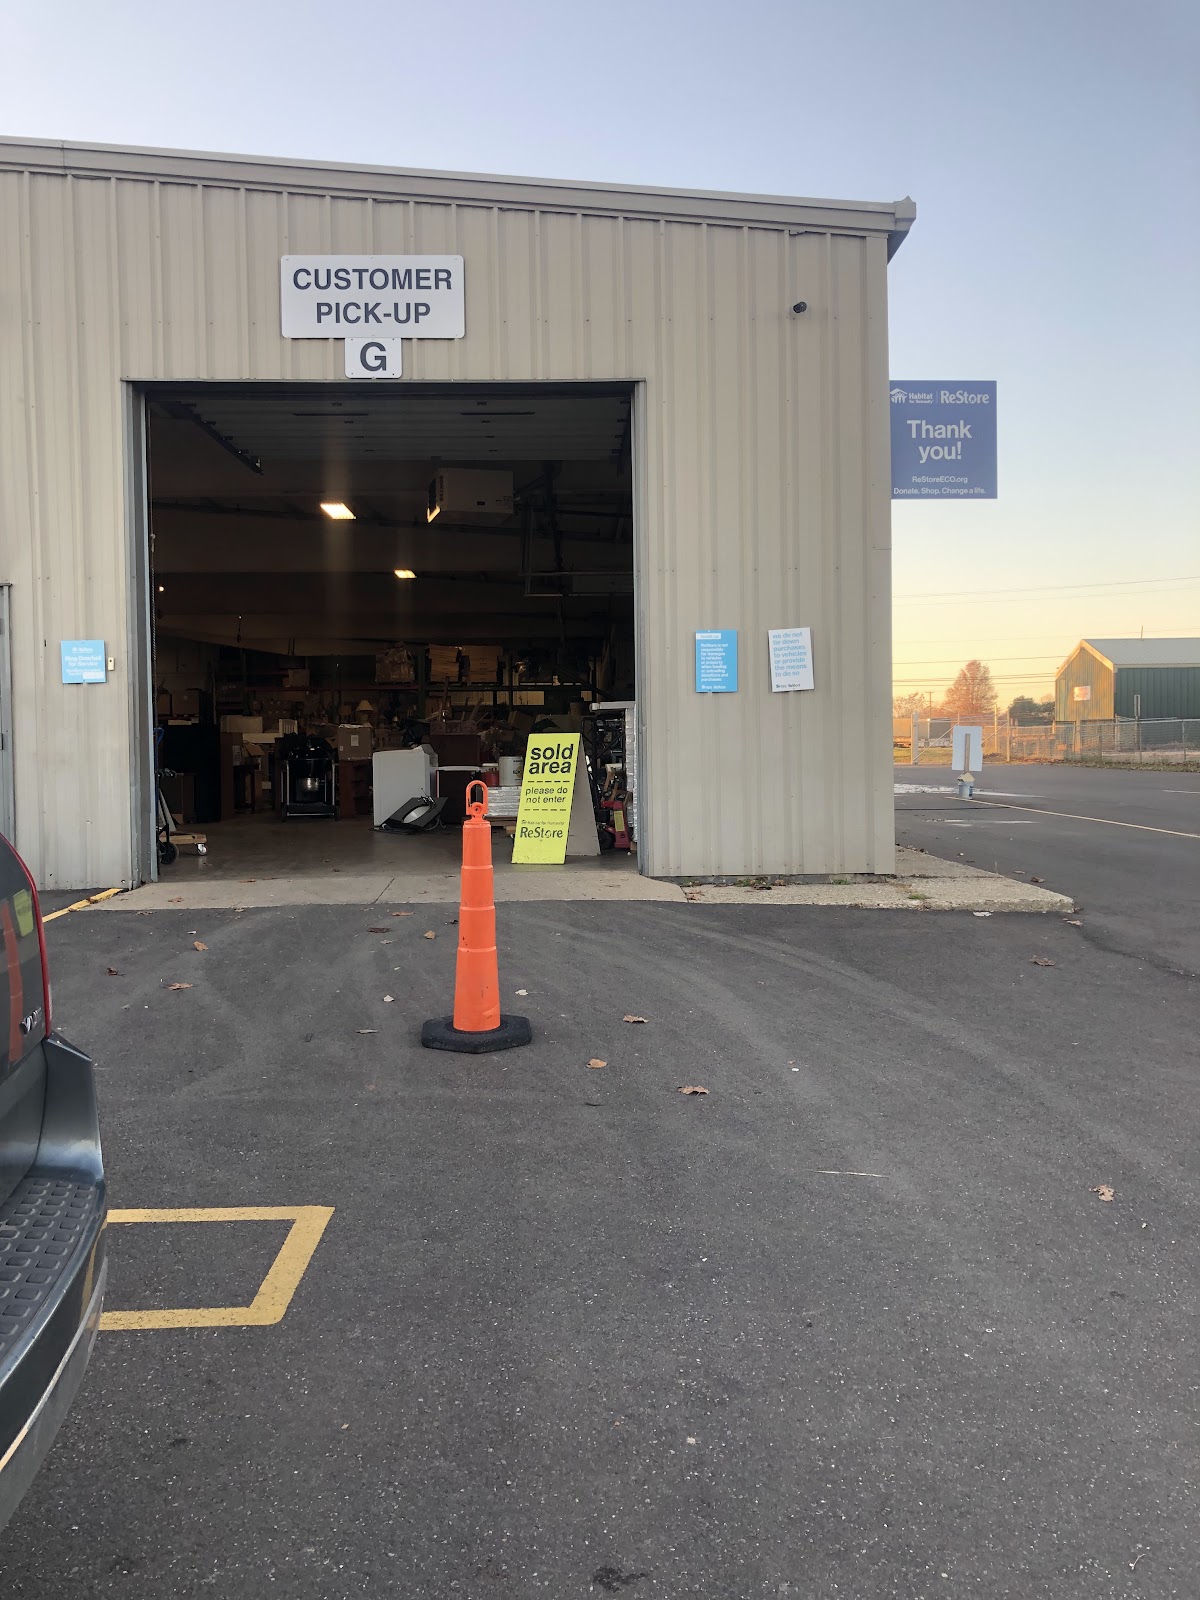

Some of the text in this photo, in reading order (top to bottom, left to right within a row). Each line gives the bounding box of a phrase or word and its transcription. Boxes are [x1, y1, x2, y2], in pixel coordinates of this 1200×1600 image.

[293, 268, 452, 290] CUSTOMER
[316, 302, 431, 324] PICK-UP
[360, 342, 387, 372] G
[908, 392, 934, 400] Habitat
[940, 390, 990, 404] ReStore
[907, 420, 972, 439] Thank
[919, 441, 962, 464] you!
[912, 476, 968, 485] ReStoreECO.org
[893, 487, 920, 495] Donate.
[921, 487, 941, 496] Shop.
[942, 487, 968, 496] Change
[782, 657, 806, 665] provide
[530, 743, 574, 760] sold
[528, 761, 572, 775] area
[525, 786, 568, 796] please do
[525, 796, 566, 804] not enter
[519, 826, 564, 839] ReStore
